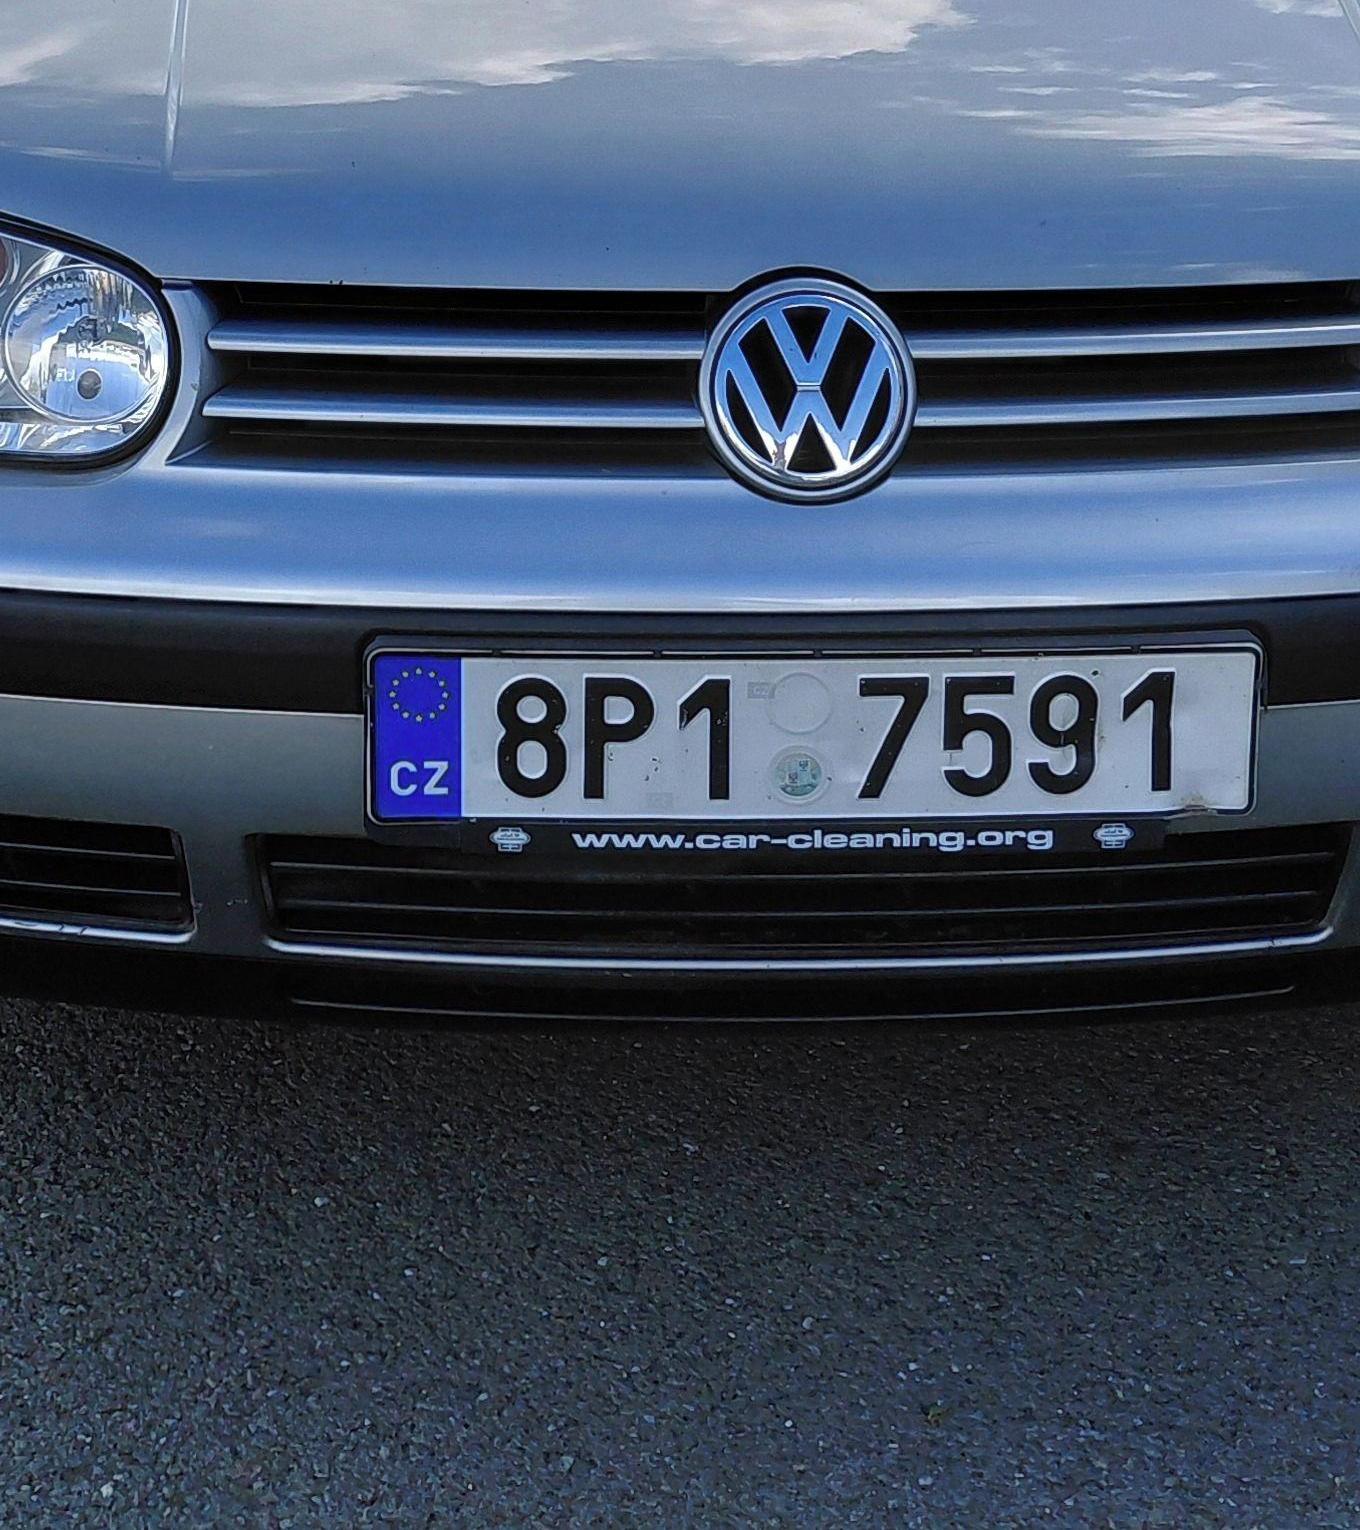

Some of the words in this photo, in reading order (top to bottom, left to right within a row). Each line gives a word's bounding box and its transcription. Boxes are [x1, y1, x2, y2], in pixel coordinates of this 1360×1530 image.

[496, 676, 731, 799] 8P1
[858, 671, 1175, 798] 7591
[390, 761, 449, 796] CZ
[572, 829, 1053, 851] www.car-cleaning.org
